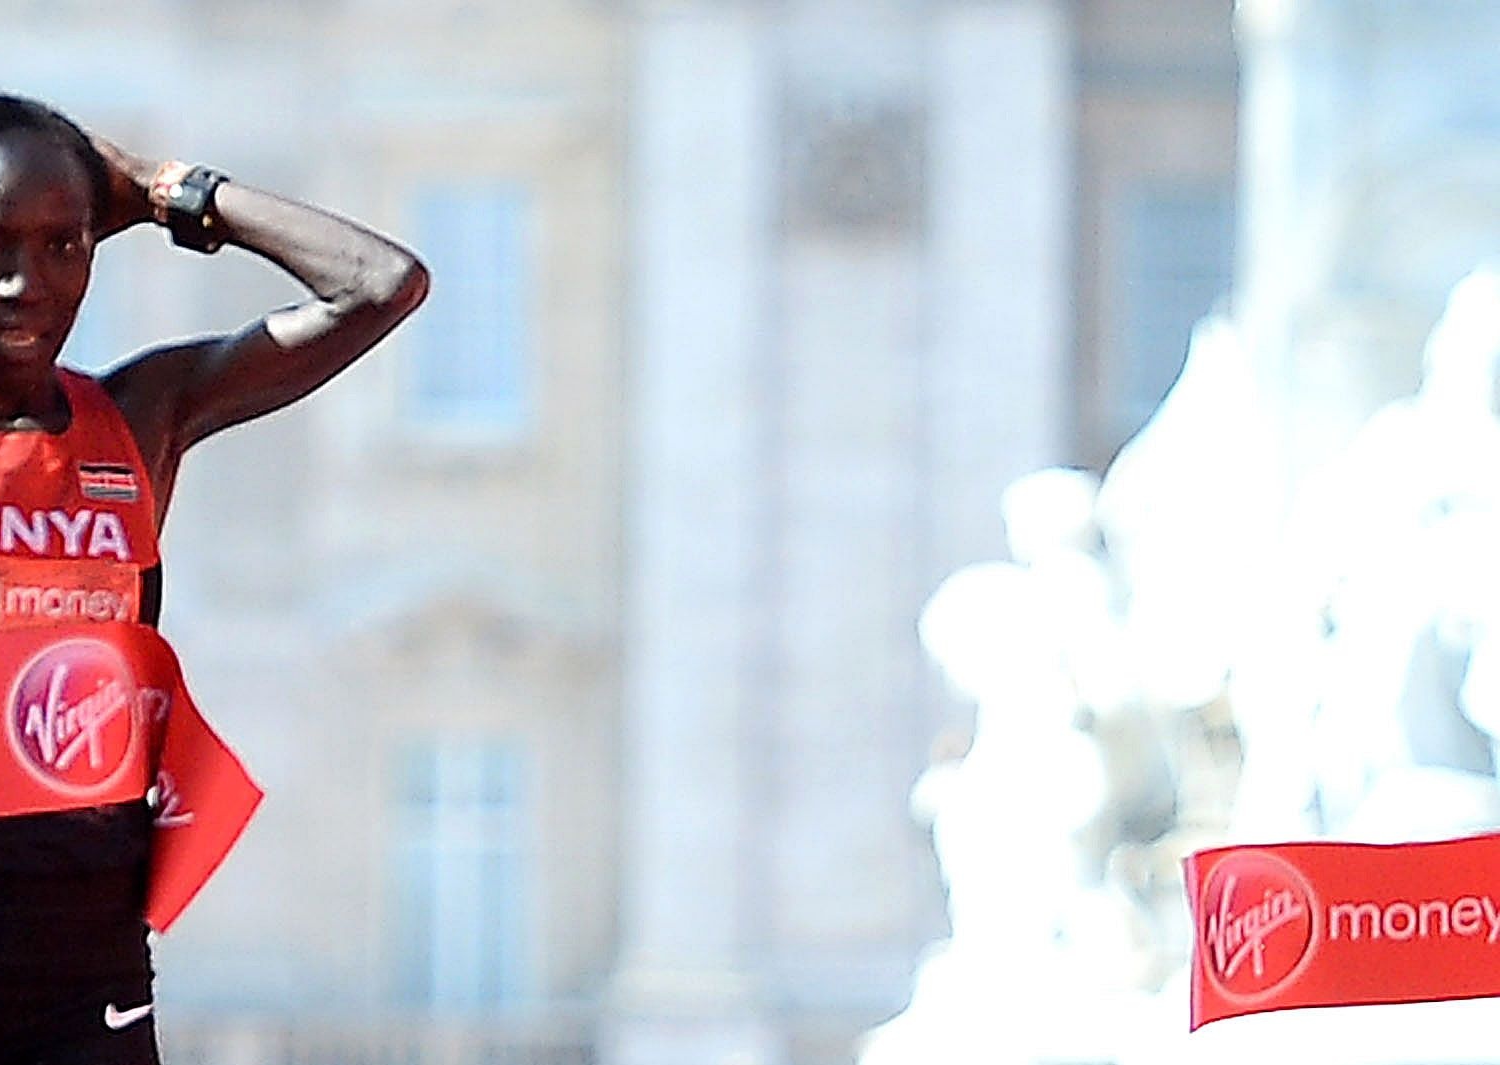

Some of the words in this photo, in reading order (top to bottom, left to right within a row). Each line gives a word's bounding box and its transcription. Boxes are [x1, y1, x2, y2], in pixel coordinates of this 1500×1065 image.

[1, 585, 130, 622] money
[24, 663, 128, 770] Virgin
[1204, 874, 1306, 979] Virgin
[1328, 893, 1500, 943] money
